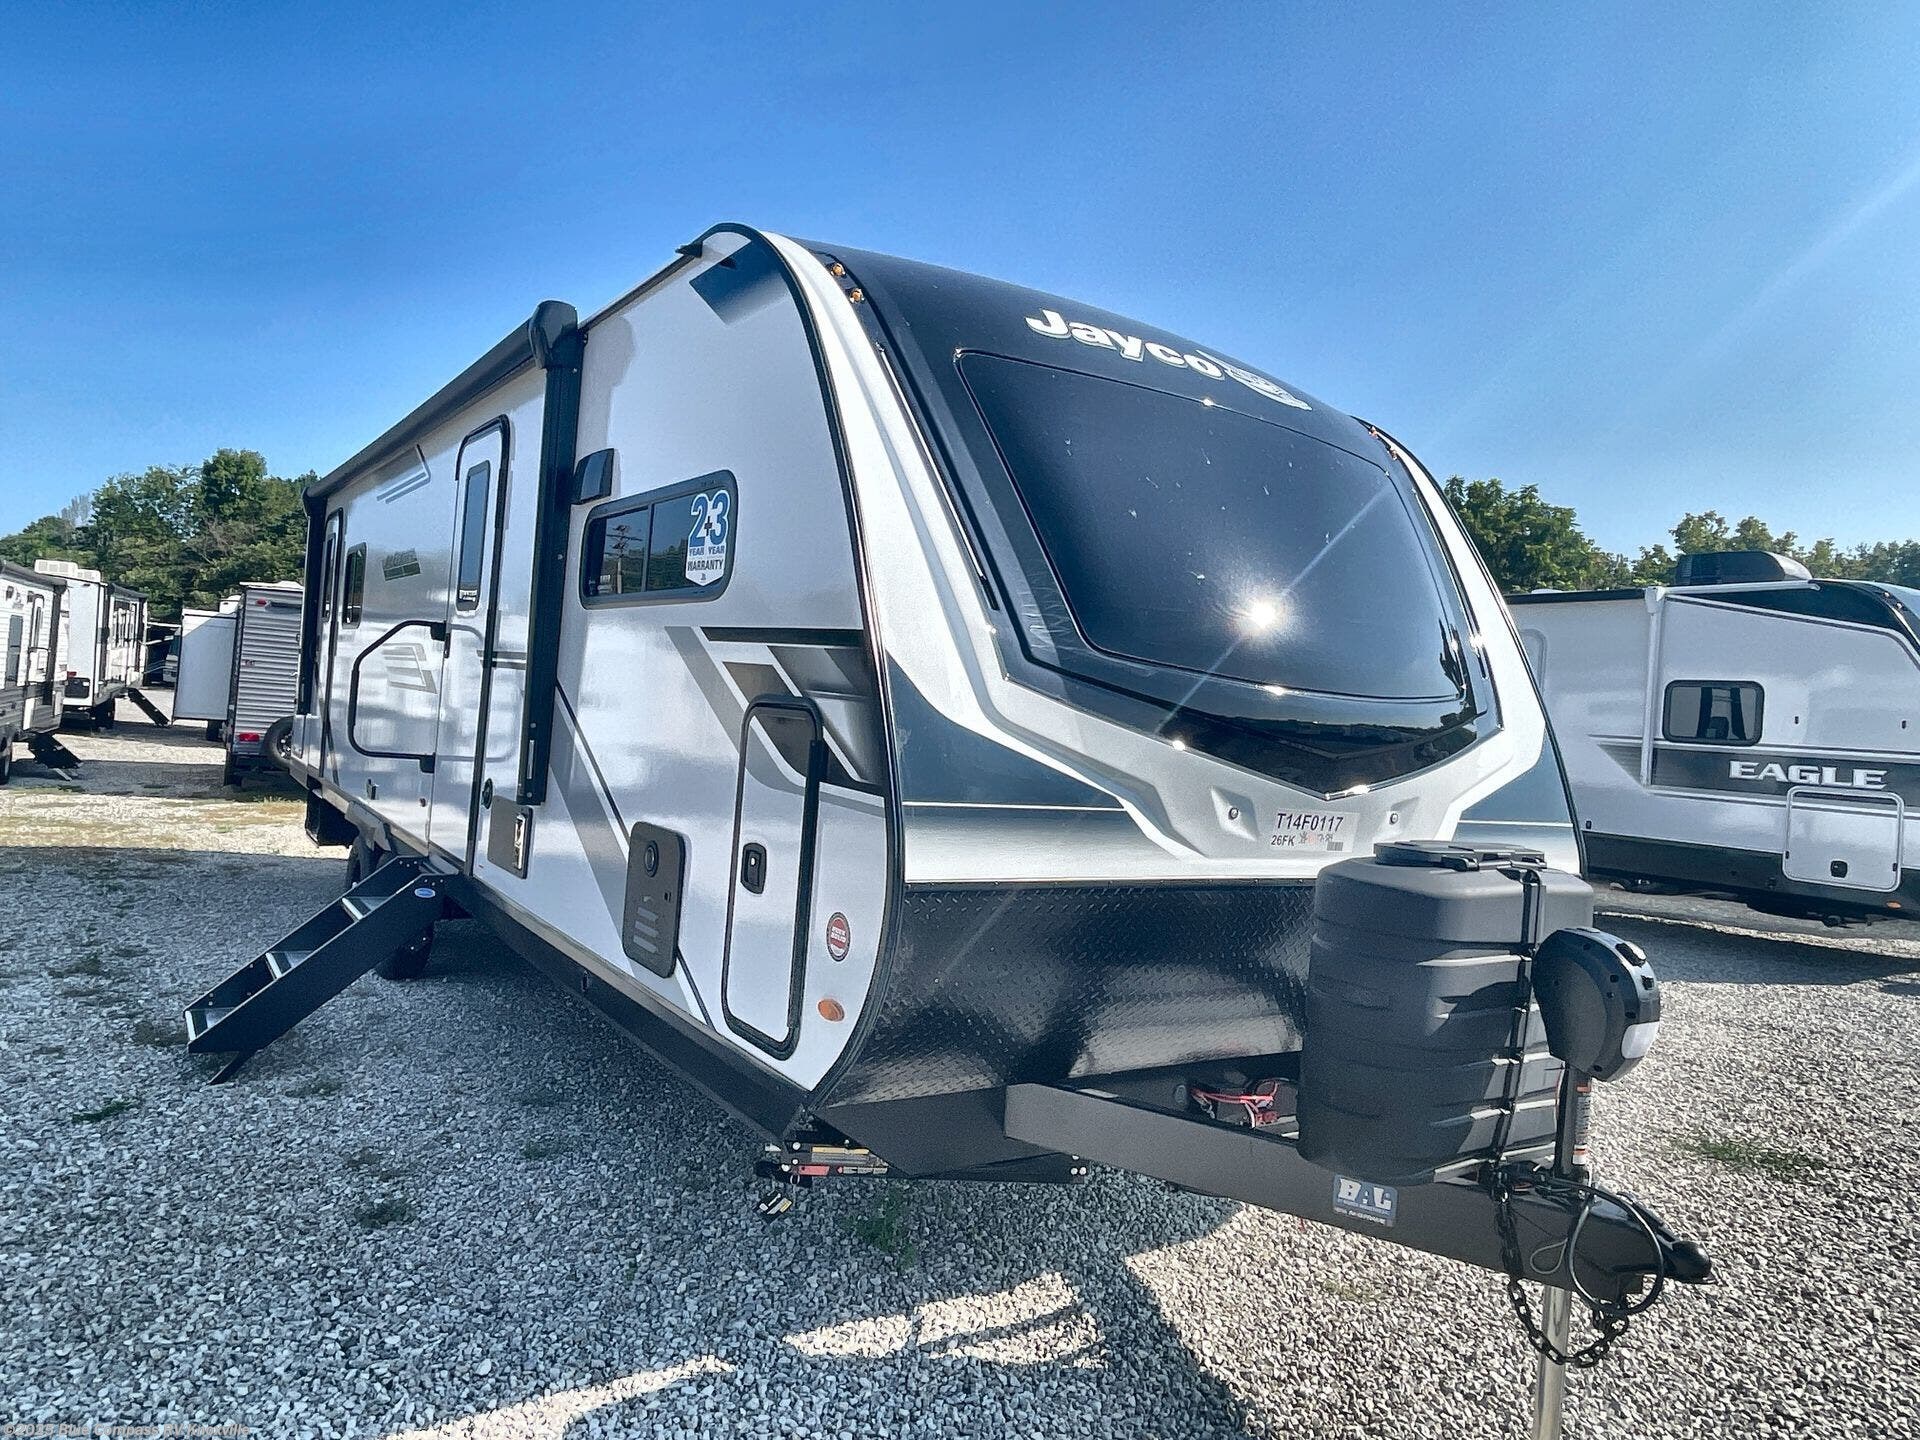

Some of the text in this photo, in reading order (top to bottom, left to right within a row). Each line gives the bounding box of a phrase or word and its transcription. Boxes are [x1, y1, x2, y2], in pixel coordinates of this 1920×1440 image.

[1024, 308, 1226, 381] Jayco
[708, 545, 725, 555] YEAR
[687, 559, 724, 572] WARRANTY
[1729, 760, 1887, 790] EAGLE
[1277, 813, 1344, 832] T14F0117
[1271, 834, 1296, 847] 26FK
